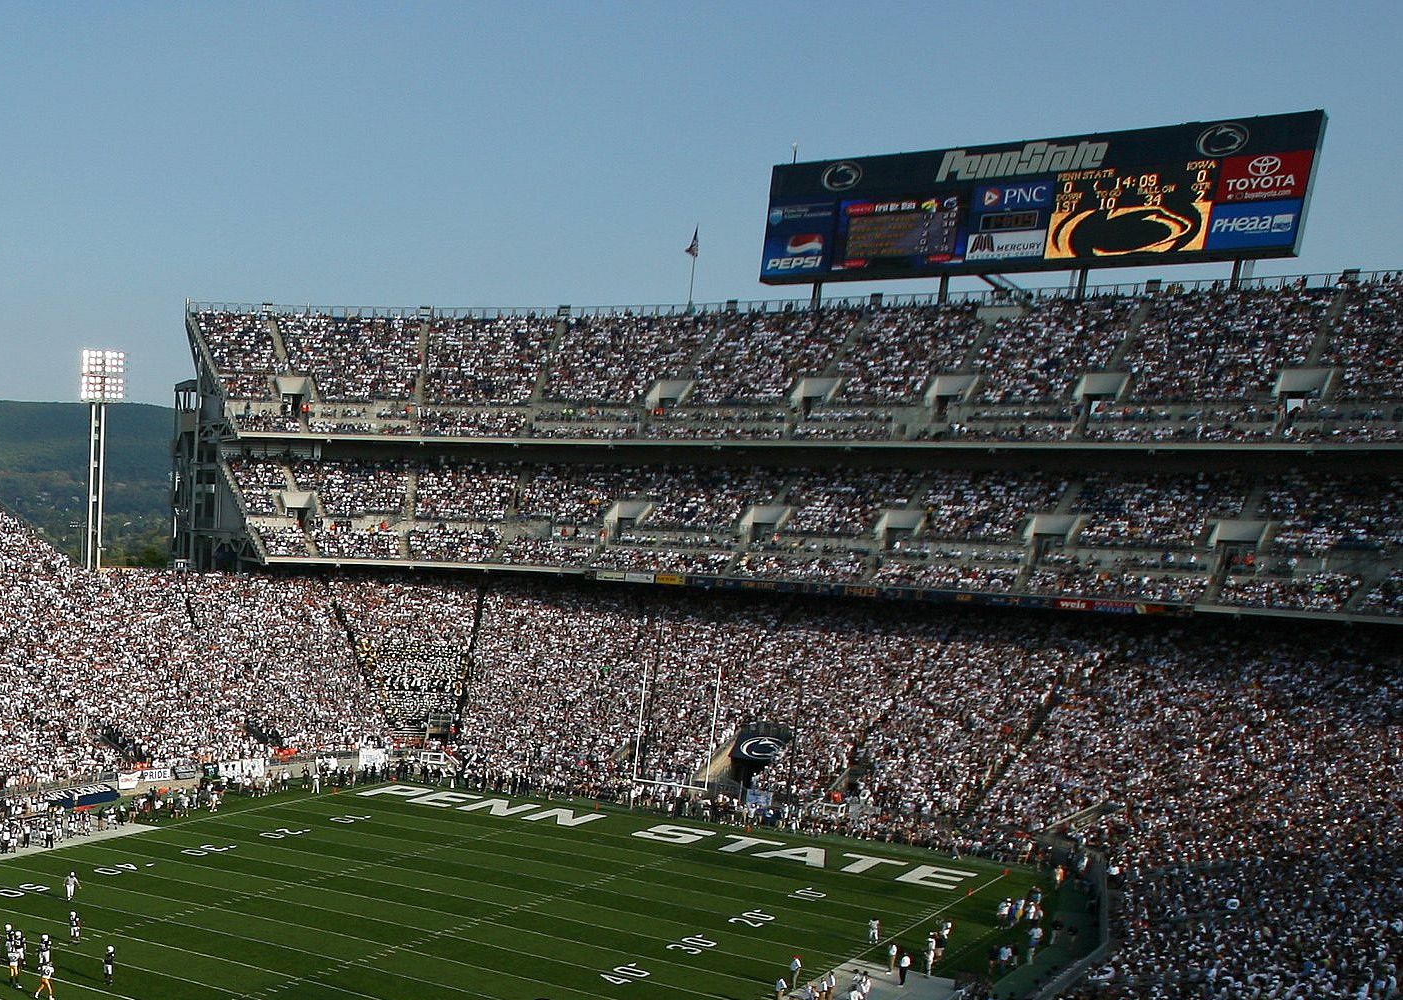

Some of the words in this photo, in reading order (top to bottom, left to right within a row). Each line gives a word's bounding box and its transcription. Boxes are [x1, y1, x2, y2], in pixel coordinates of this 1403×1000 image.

[1186, 160, 1218, 171] IOWA
[1057, 171, 1082, 182] PENN
[1082, 168, 1117, 180] STATE
[1115, 174, 1160, 189] 14:09
[1197, 170, 1207, 182] 0
[1064, 182, 1074, 194] 0
[1226, 174, 1296, 192] TOYOTA
[1004, 186, 1047, 205] PNC
[1144, 194, 1164, 207] 34
[1195, 191, 1206, 203] 2
[1055, 201, 1077, 213] 1ST
[1099, 198, 1117, 211] 10
[997, 241, 1043, 252] MERCURY
[767, 255, 824, 271] PEPSI
[1060, 600, 1087, 609] weis
[258, 827, 301, 839] 20
[356, 783, 608, 828] PENN
[630, 823, 979, 891] STATE
[180, 842, 228, 856] 30
[93, 862, 138, 876] 40
[727, 910, 776, 929] 20
[665, 935, 718, 956] 30
[600, 965, 652, 986] 40
